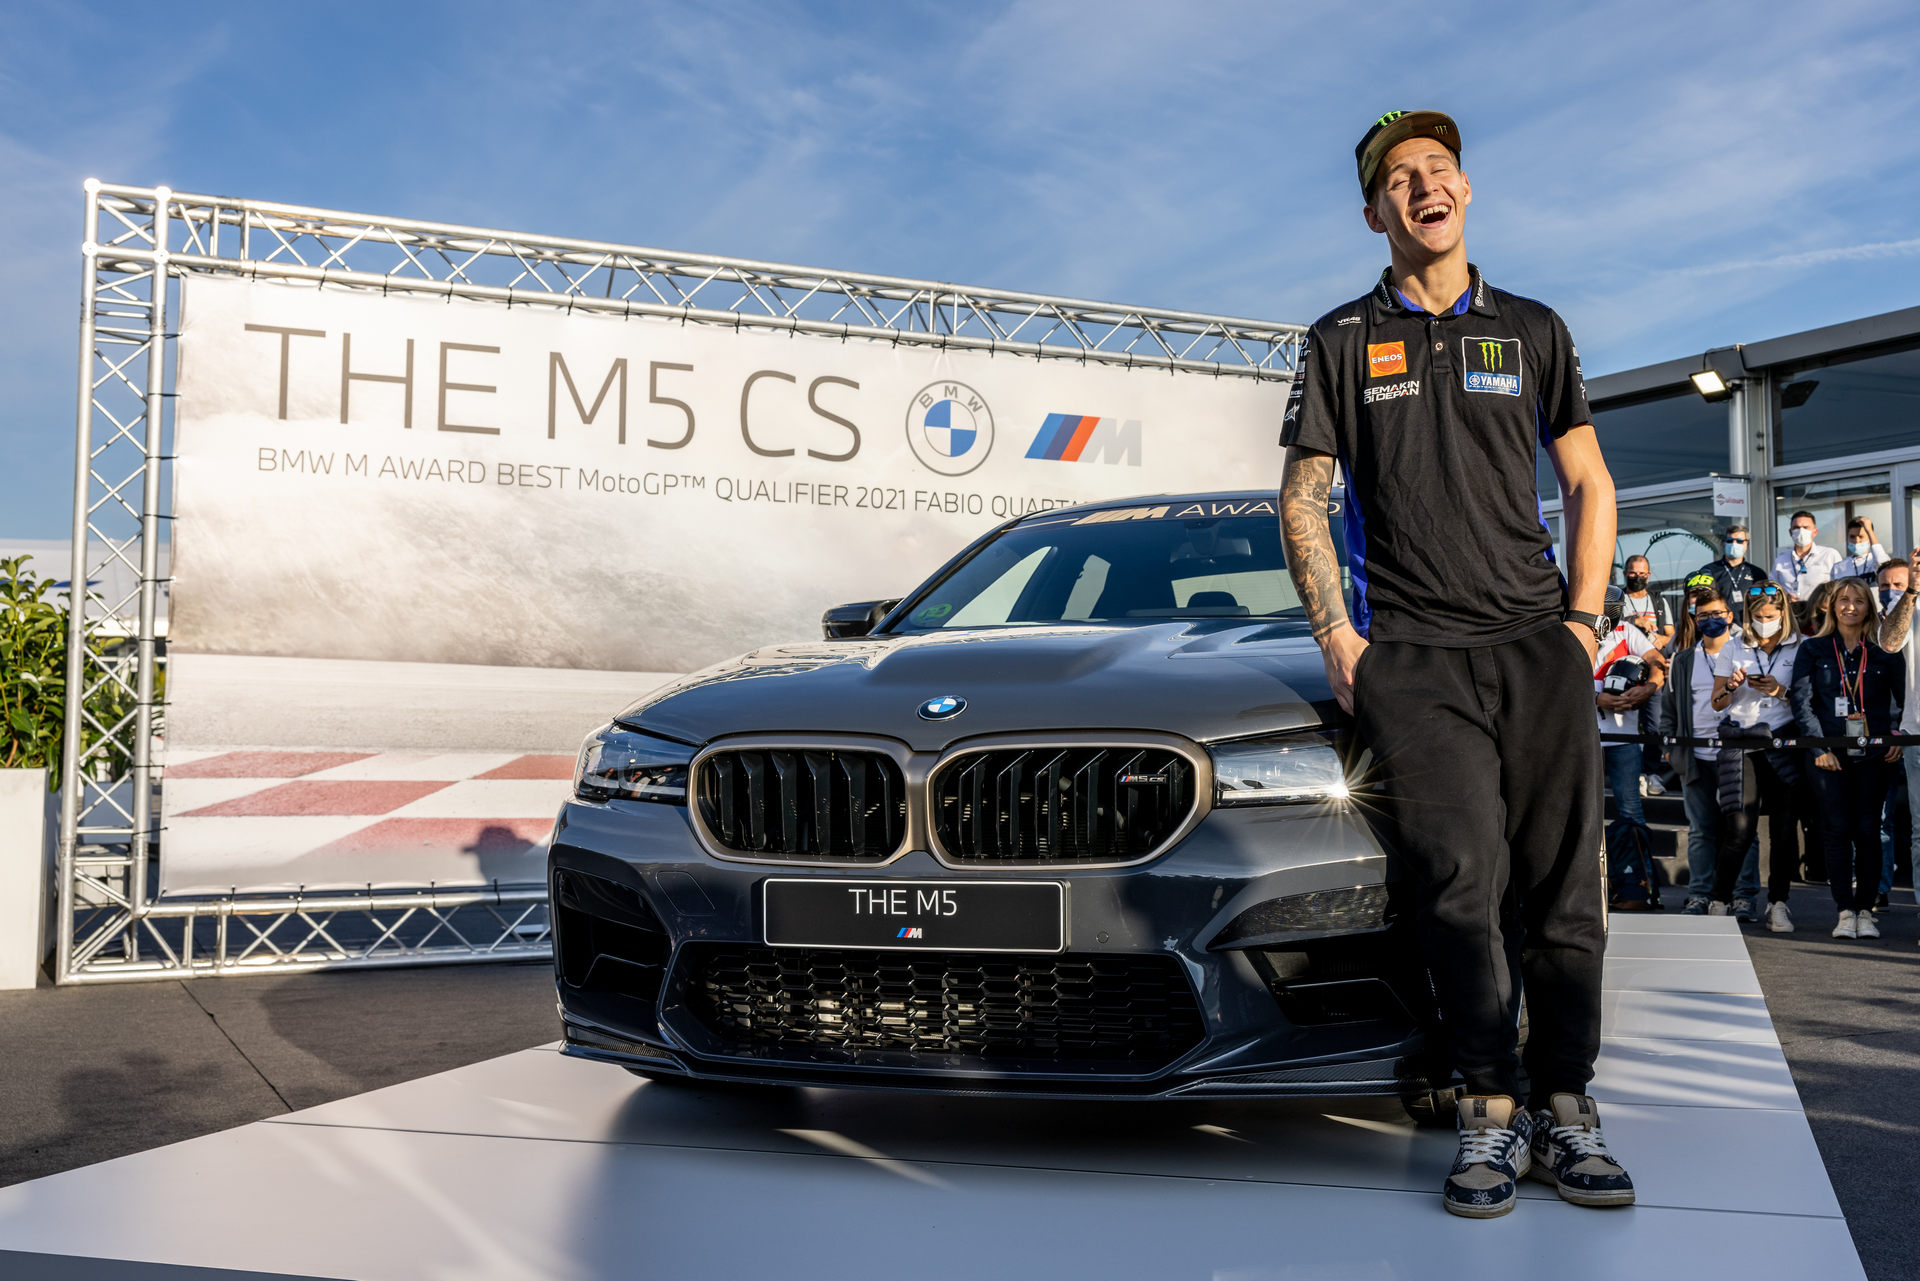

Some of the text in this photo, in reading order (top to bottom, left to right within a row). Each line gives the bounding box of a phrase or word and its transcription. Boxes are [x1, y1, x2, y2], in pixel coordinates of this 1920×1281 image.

[1371, 353, 1403, 364] ENEOS
[244, 323, 861, 462] THE M5 CS
[1480, 375, 1518, 389] YAMAHA
[918, 385, 984, 413] BMW
[258, 447, 335, 475] BMW
[345, 453, 368, 477] M
[378, 456, 486, 484] AWARD
[497, 462, 571, 489] BEST
[715, 477, 849, 507] QUALIFIER
[855, 486, 906, 510] 2021
[914, 490, 983, 515] FABIO
[1687, 574, 1715, 587] 46
[848, 888, 958, 916] THE M5
